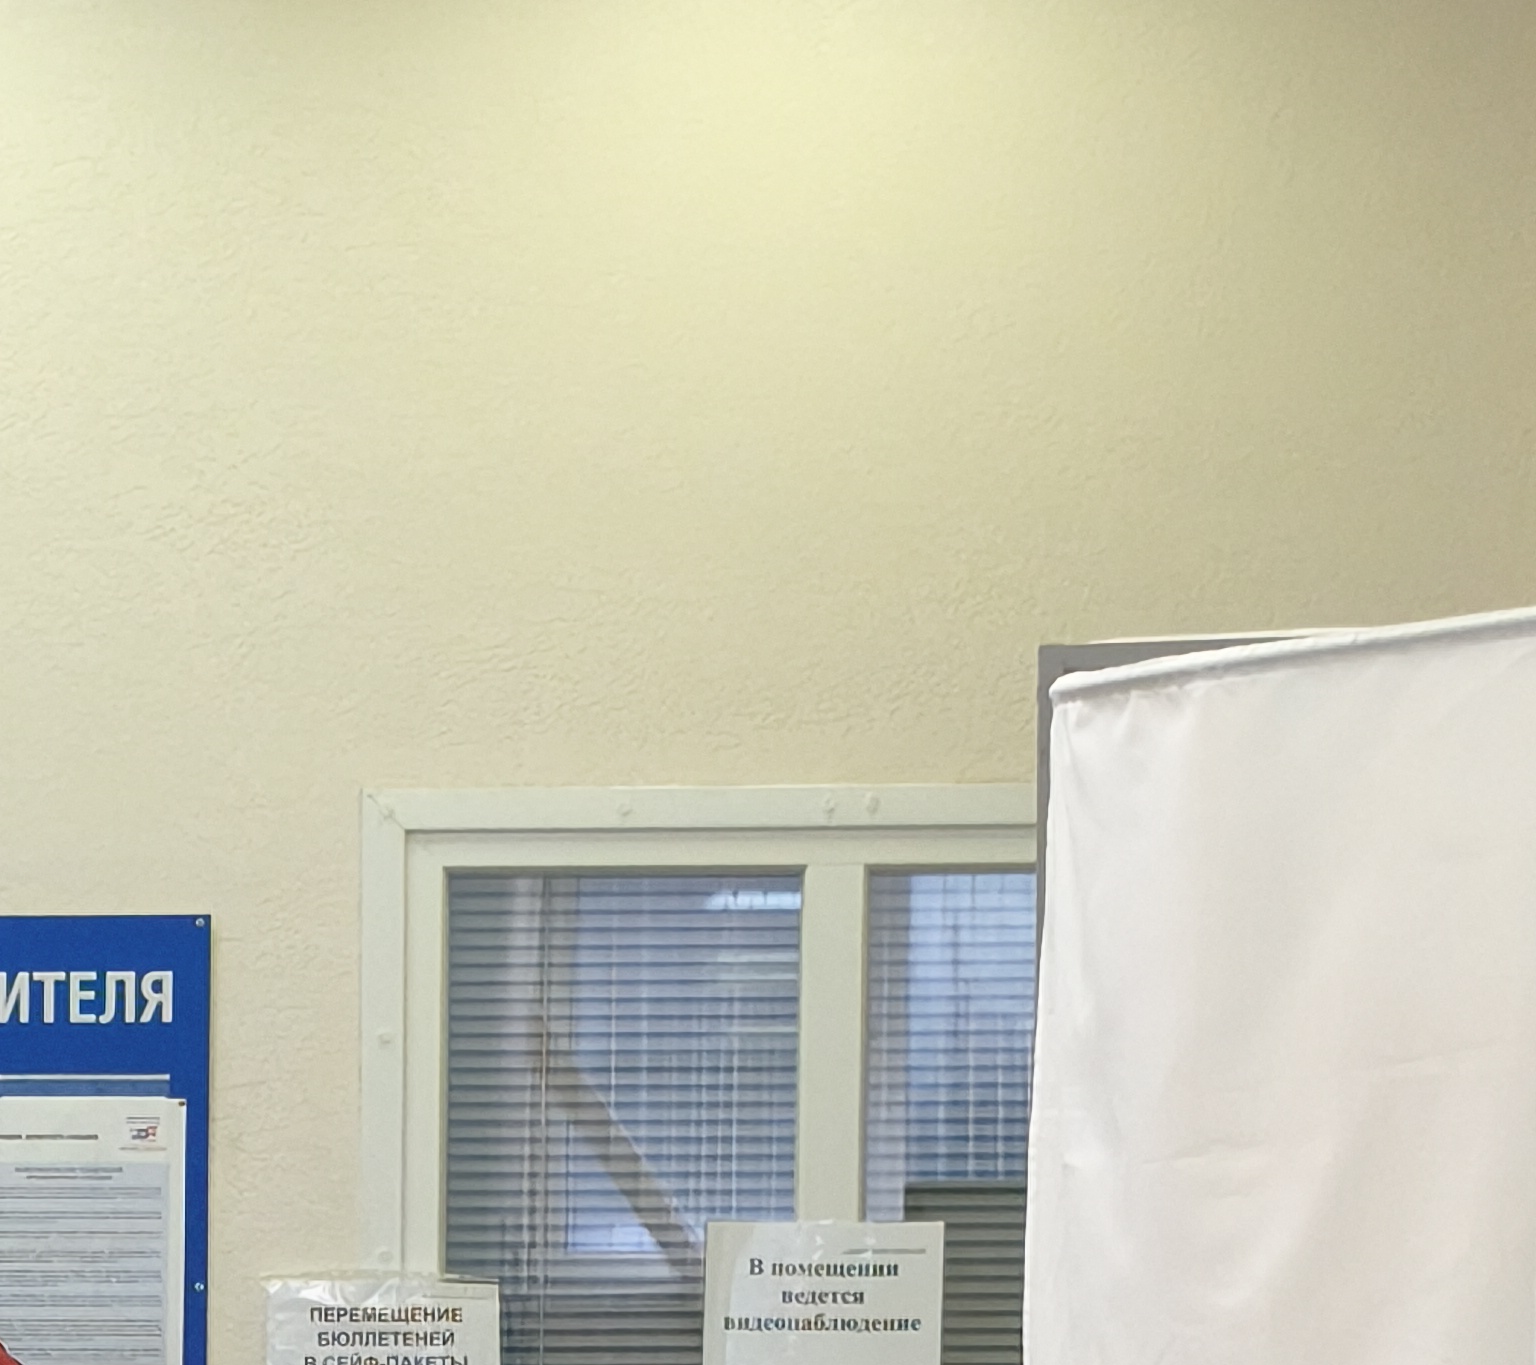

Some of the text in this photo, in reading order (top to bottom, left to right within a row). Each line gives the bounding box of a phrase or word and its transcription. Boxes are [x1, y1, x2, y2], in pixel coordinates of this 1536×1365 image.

[748, 1257, 899, 1278] В помещении
[781, 1289, 865, 1305] ведется
[310, 1306, 463, 1325] ПЕРЕМЕЩЕНИЕ
[723, 1312, 922, 1333] видеонаблюдение
[317, 1329, 455, 1347] БЮЛЛЕТЕНЕЙ
